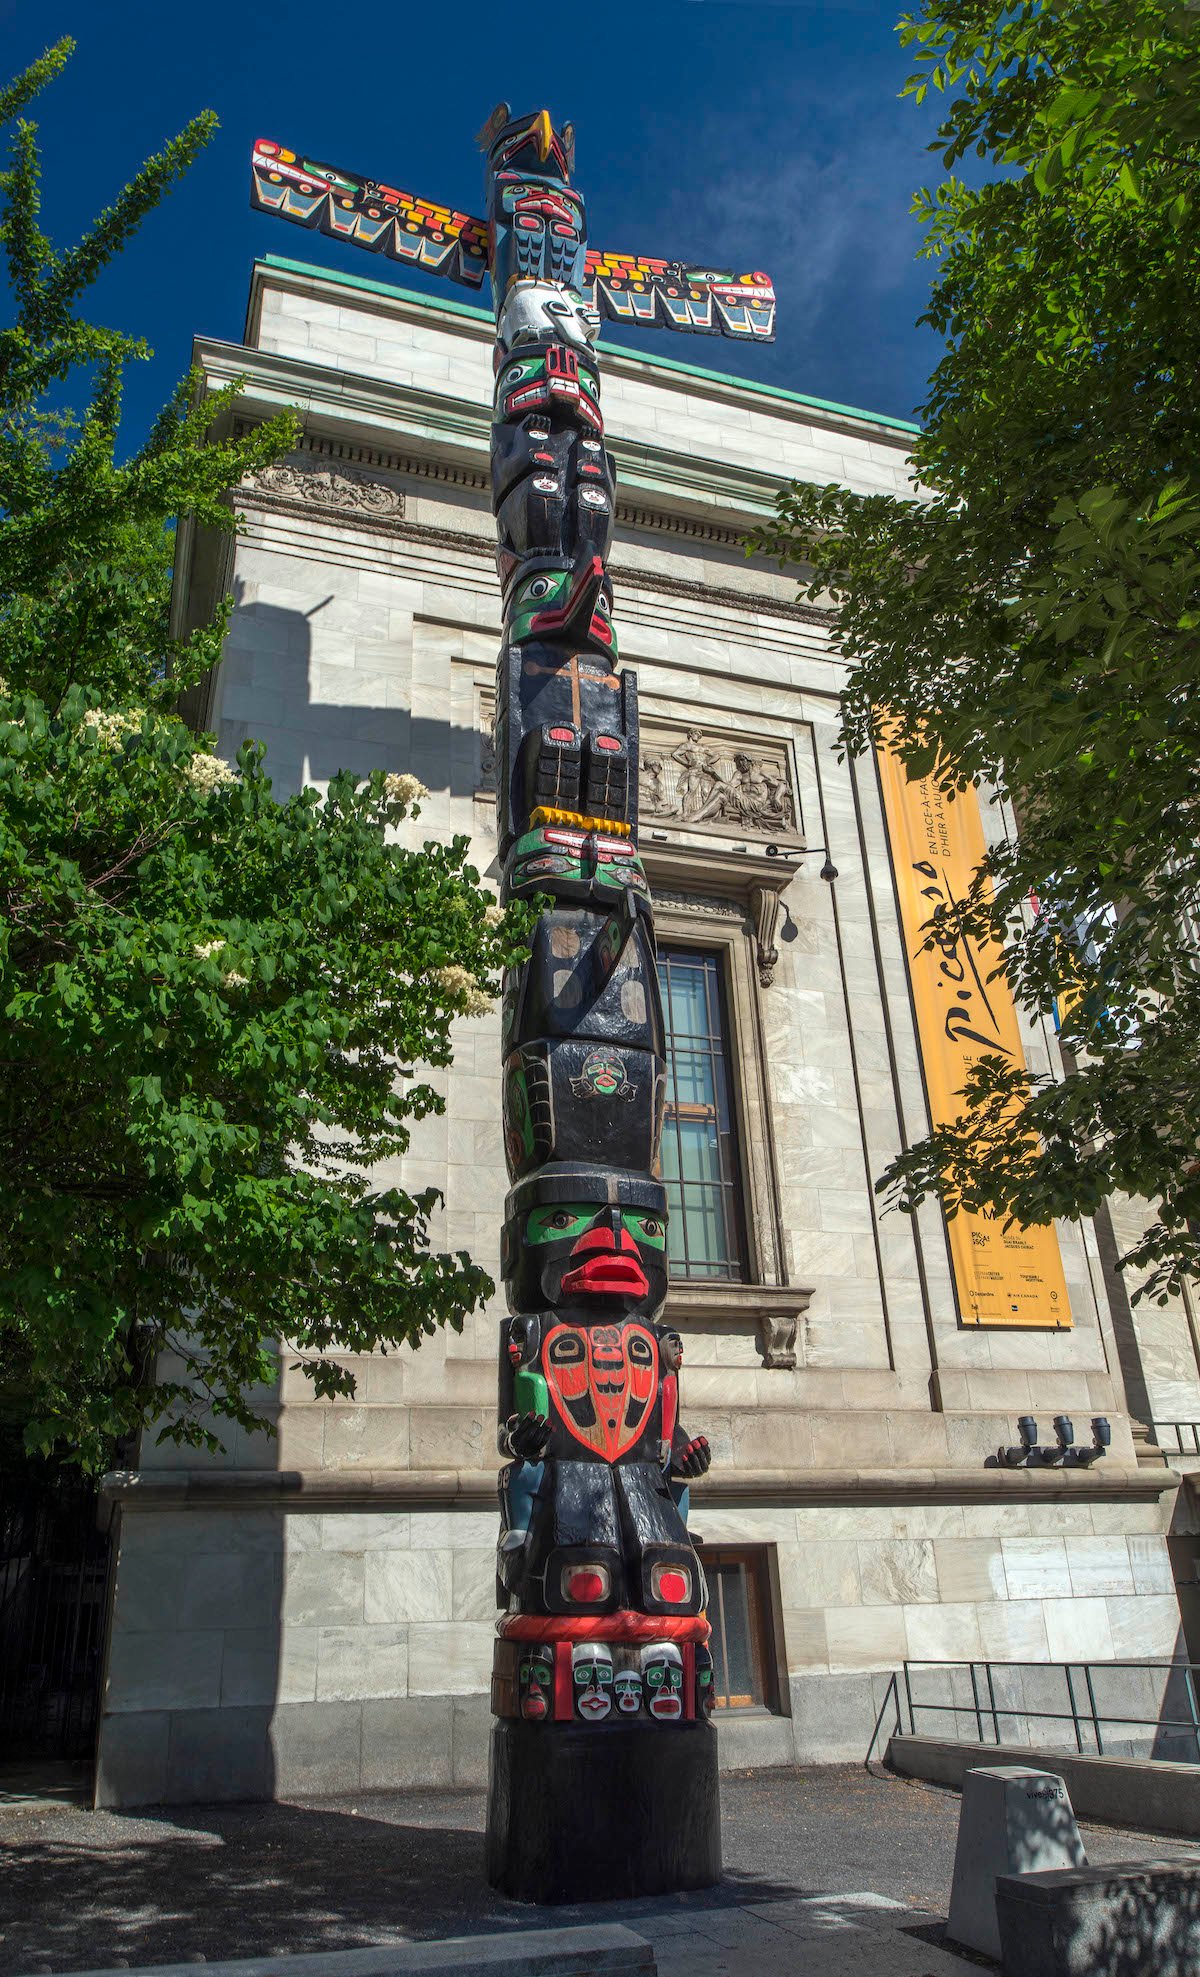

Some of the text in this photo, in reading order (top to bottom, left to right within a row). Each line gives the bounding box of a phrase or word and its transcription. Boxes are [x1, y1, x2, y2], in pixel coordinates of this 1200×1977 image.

[920, 777, 938, 855] EN FACE-À-FAC
[935, 812, 945, 821] À
[938, 823, 951, 857] D'HIER
[1049, 1788, 1064, 1800] 375
